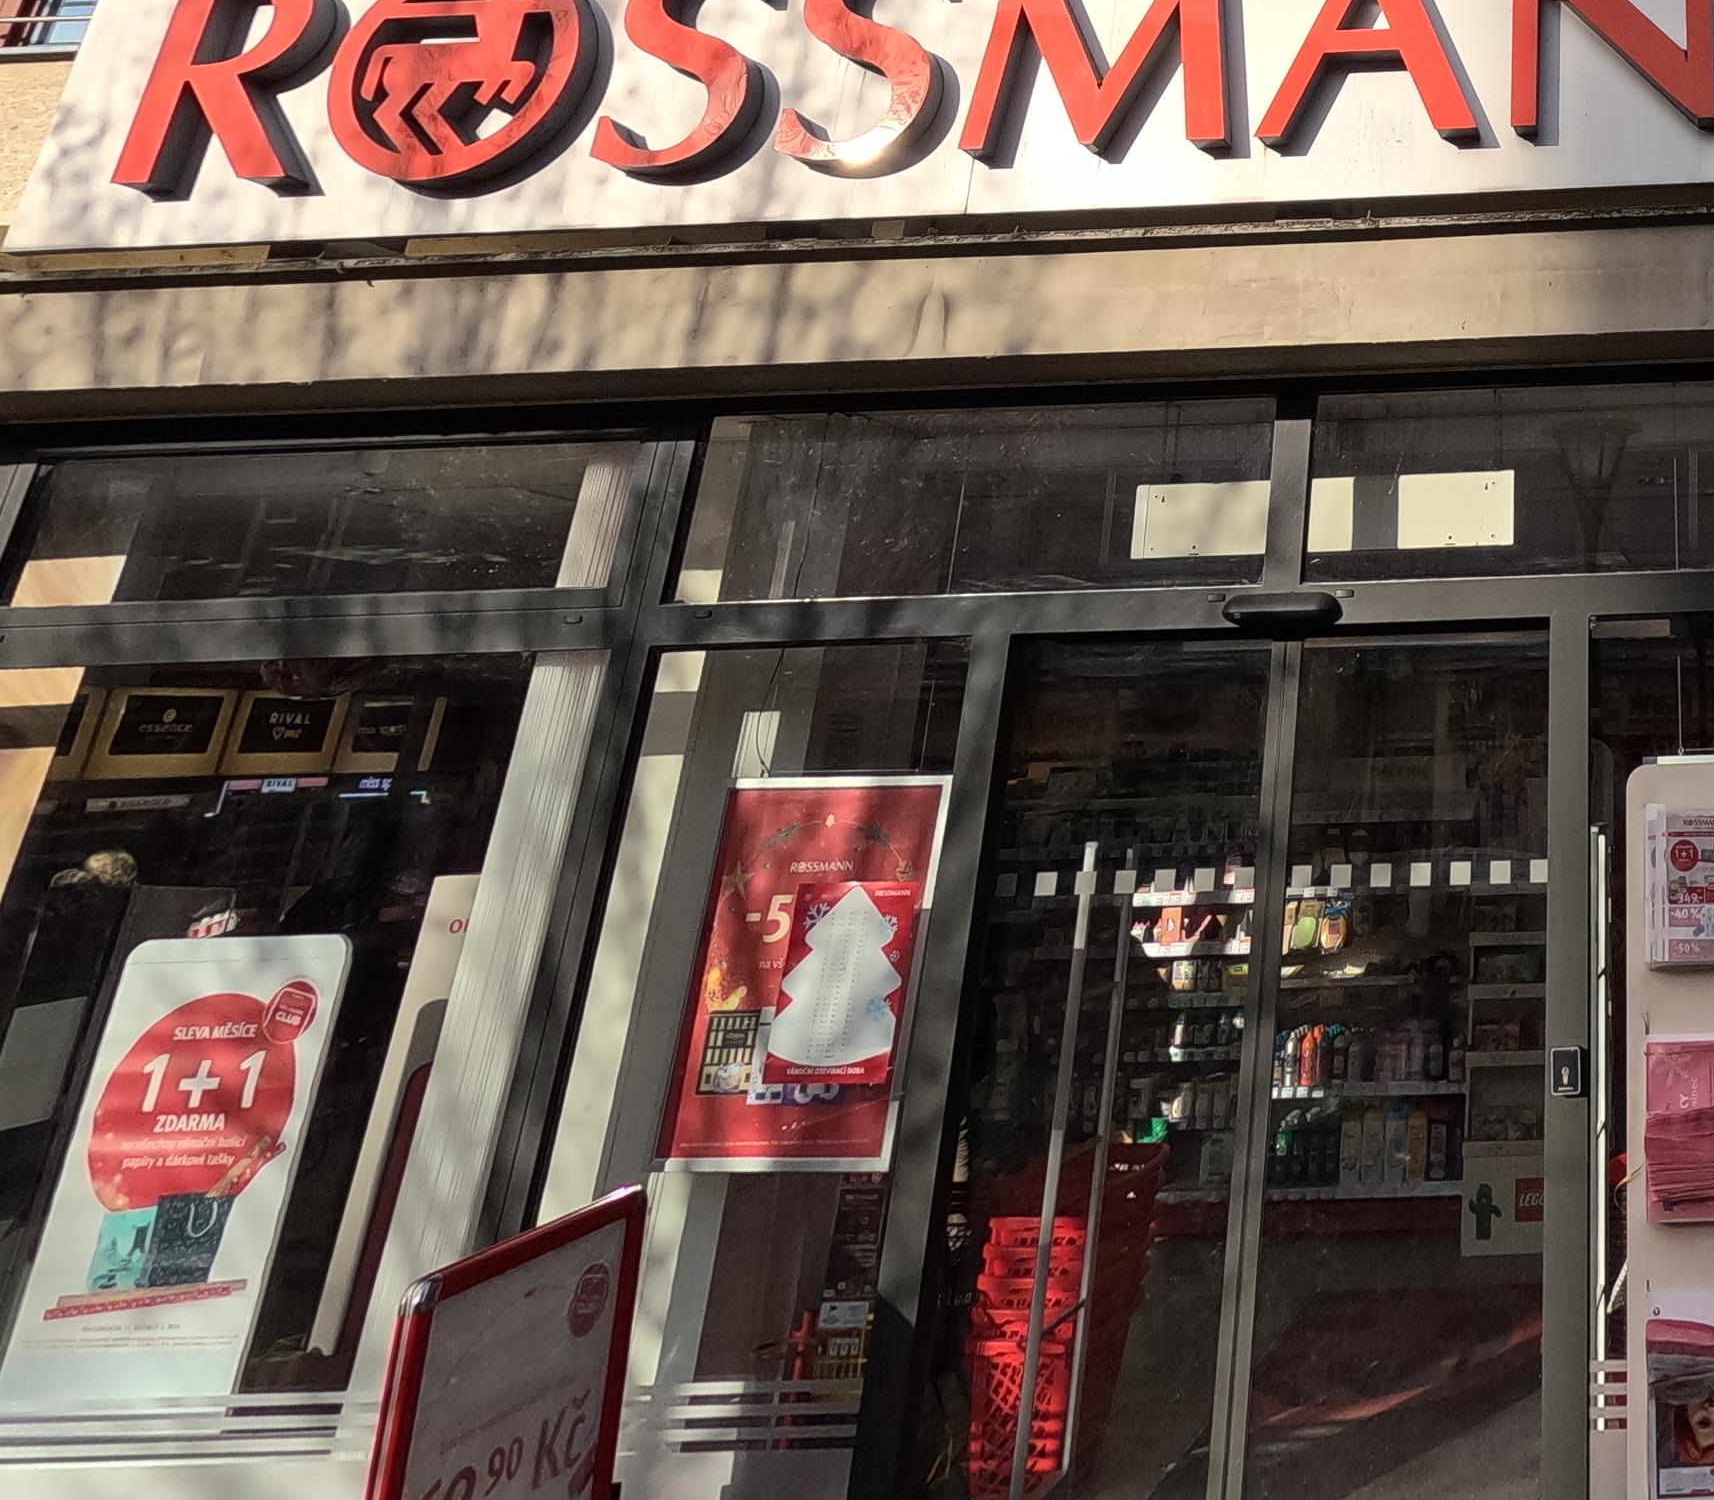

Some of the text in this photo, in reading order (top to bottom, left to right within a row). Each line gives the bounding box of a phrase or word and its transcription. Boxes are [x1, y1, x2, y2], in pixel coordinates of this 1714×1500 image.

[268, 711, 311, 725] RIVAL
[138, 721, 193, 734] essence
[789, 859, 855, 874] ROSSMANN
[171, 1021, 259, 1041] SLEVA MĚSÍCE
[153, 1112, 225, 1134] ZDARMA
